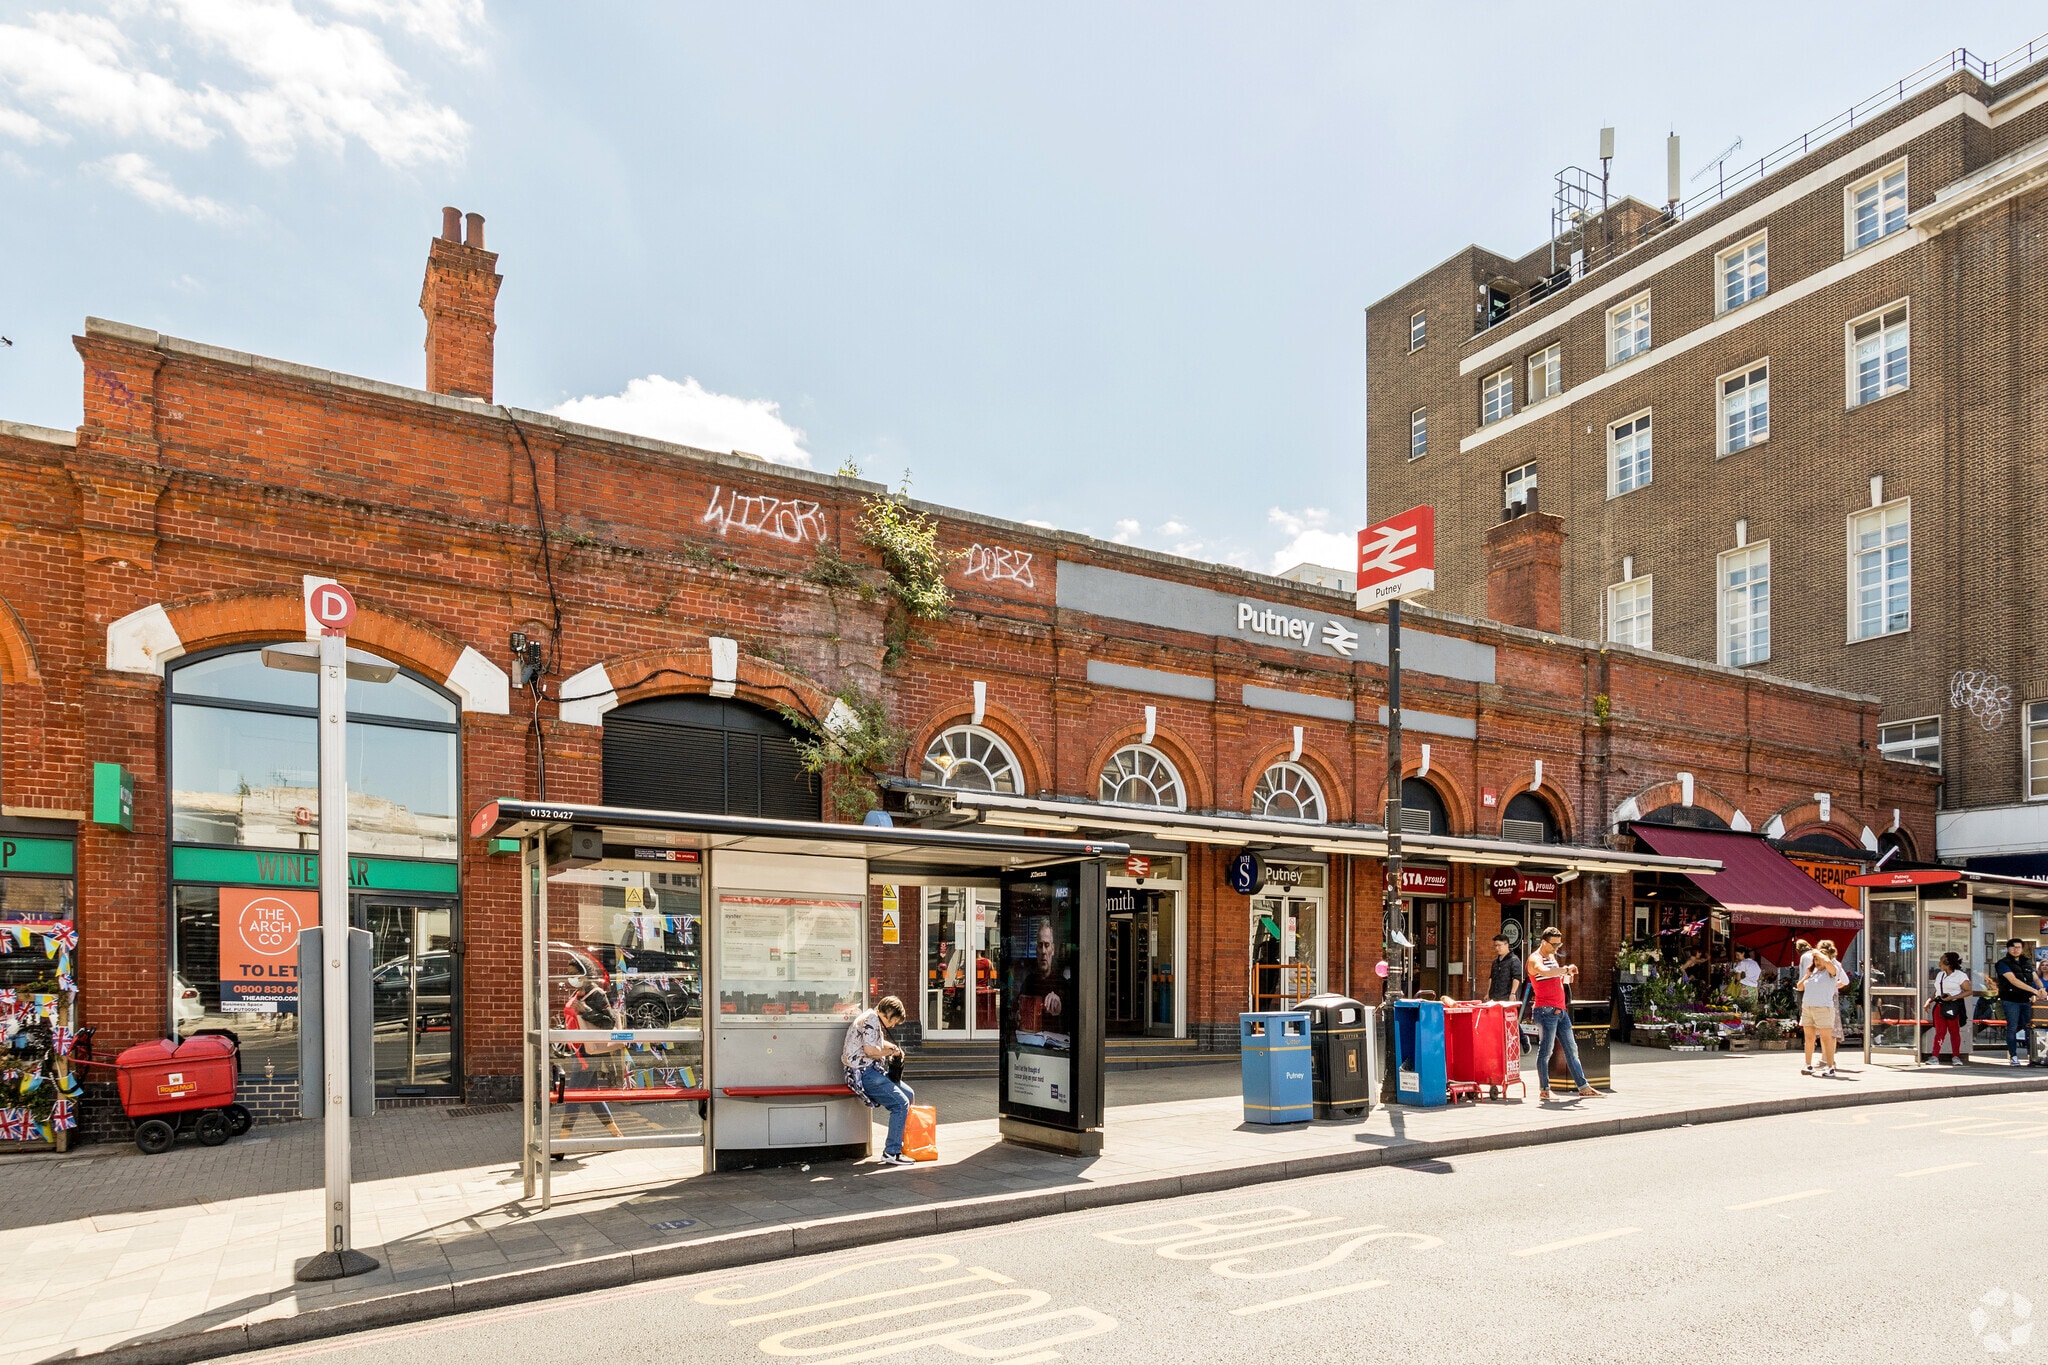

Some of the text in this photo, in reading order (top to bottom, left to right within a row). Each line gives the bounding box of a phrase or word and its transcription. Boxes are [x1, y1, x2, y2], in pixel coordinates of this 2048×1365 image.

[1375, 582, 1403, 598] Putney
[321, 590, 348, 621] D
[1237, 602, 1315, 647] Putney
[530, 808, 574, 820] 0132 0427
[256, 853, 315, 883] WINE
[1239, 862, 1250, 887] S
[1265, 867, 1303, 885] Putney
[1423, 875, 1447, 886] pronto
[1493, 879, 1517, 888] COSTA
[1536, 882, 1556, 893] pronto
[1055, 886, 1069, 898] NHS
[1497, 888, 1513, 896] pronto
[1106, 889, 1135, 911] mith
[255, 908, 285, 921] THE
[249, 921, 292, 933] ARCH
[1779, 916, 1801, 925] DOVERS
[1803, 918, 1825, 927] FLORIST
[258, 934, 283, 945] CO
[239, 964, 265, 977] TO
[268, 965, 298, 977] LET
[233, 985, 263, 993] 0800
[263, 985, 285, 994] 830
[1286, 1071, 1304, 1080] Putney
[160, 1085, 180, 1094] Royal
[1092, 1204, 1445, 1281] BUS
